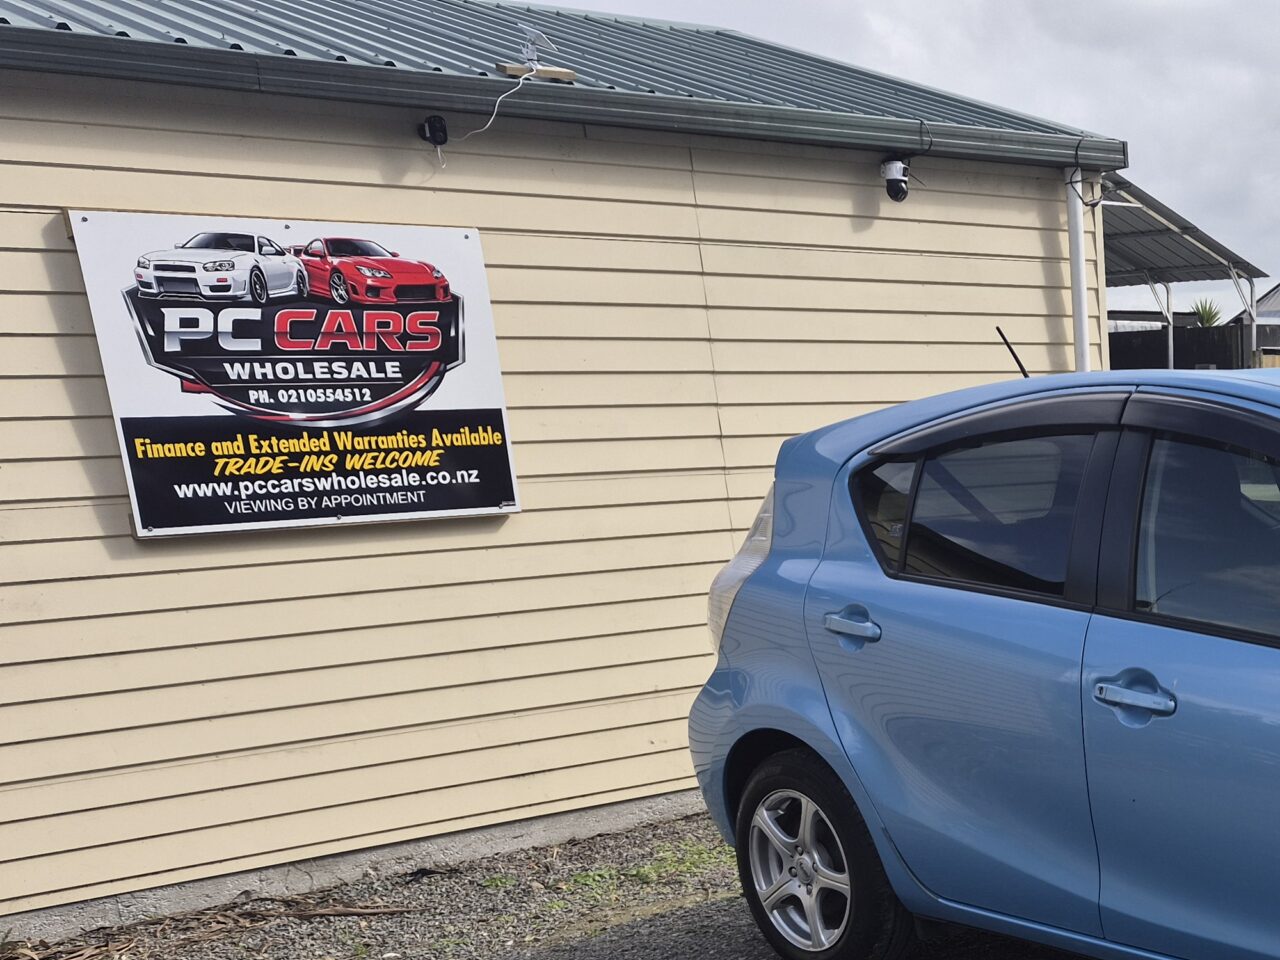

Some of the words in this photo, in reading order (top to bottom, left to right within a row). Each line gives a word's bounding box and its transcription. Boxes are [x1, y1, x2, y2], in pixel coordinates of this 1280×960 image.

[160, 308, 262, 351] PC
[274, 309, 442, 351] CARS
[223, 361, 402, 380] WHOLESALE
[249, 390, 274, 403] PH.
[280, 388, 372, 403] 0210554512
[134, 438, 205, 458] Finance
[211, 434, 245, 455] and
[248, 431, 330, 454] Extended
[333, 430, 427, 451] Warranties
[431, 426, 502, 447] Available
[213, 454, 338, 476] TRADE-INS
[345, 450, 445, 470] WELCOME
[174, 469, 480, 499] www.pccarswholesale.co.nz
[224, 499, 294, 514] VIEWING
[298, 496, 317, 510] BY
[321, 490, 426, 509] APPOINTMENT
